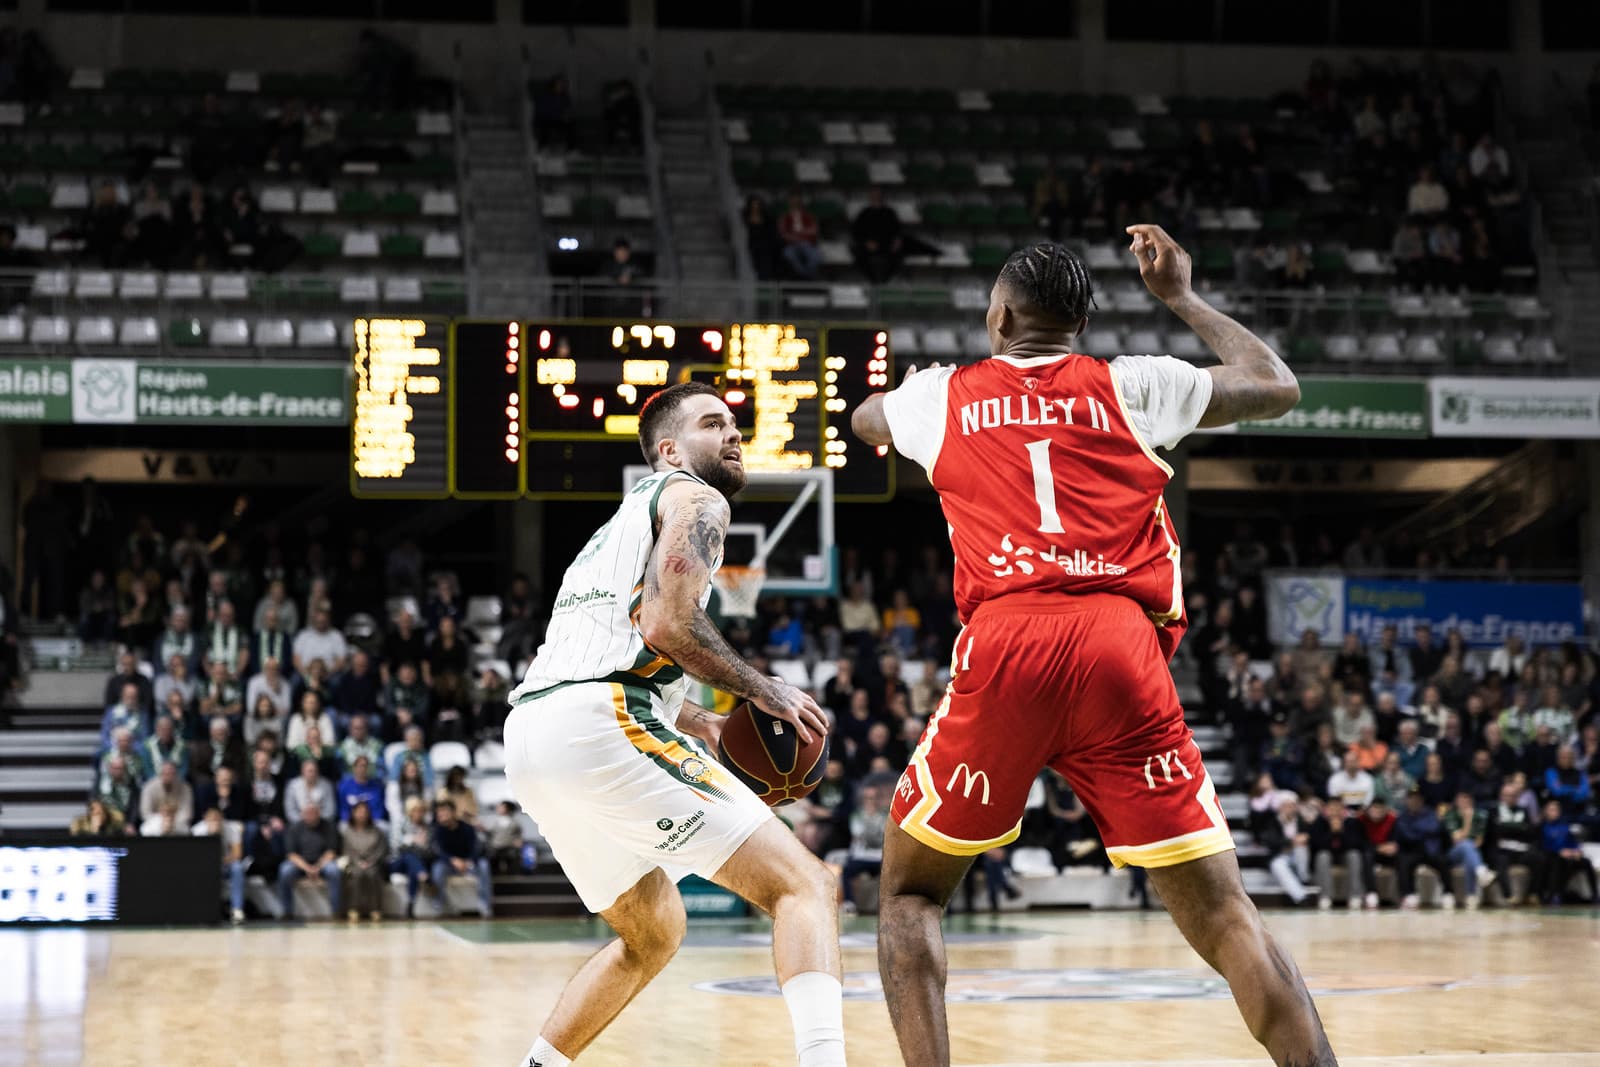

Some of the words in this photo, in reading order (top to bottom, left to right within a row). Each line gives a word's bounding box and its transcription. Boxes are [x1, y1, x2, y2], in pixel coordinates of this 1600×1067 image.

[139, 369, 207, 392] Région
[139, 391, 343, 417] Hauts-de-France
[961, 394, 1077, 436] NOLLEY
[1024, 438, 1066, 534] 1
